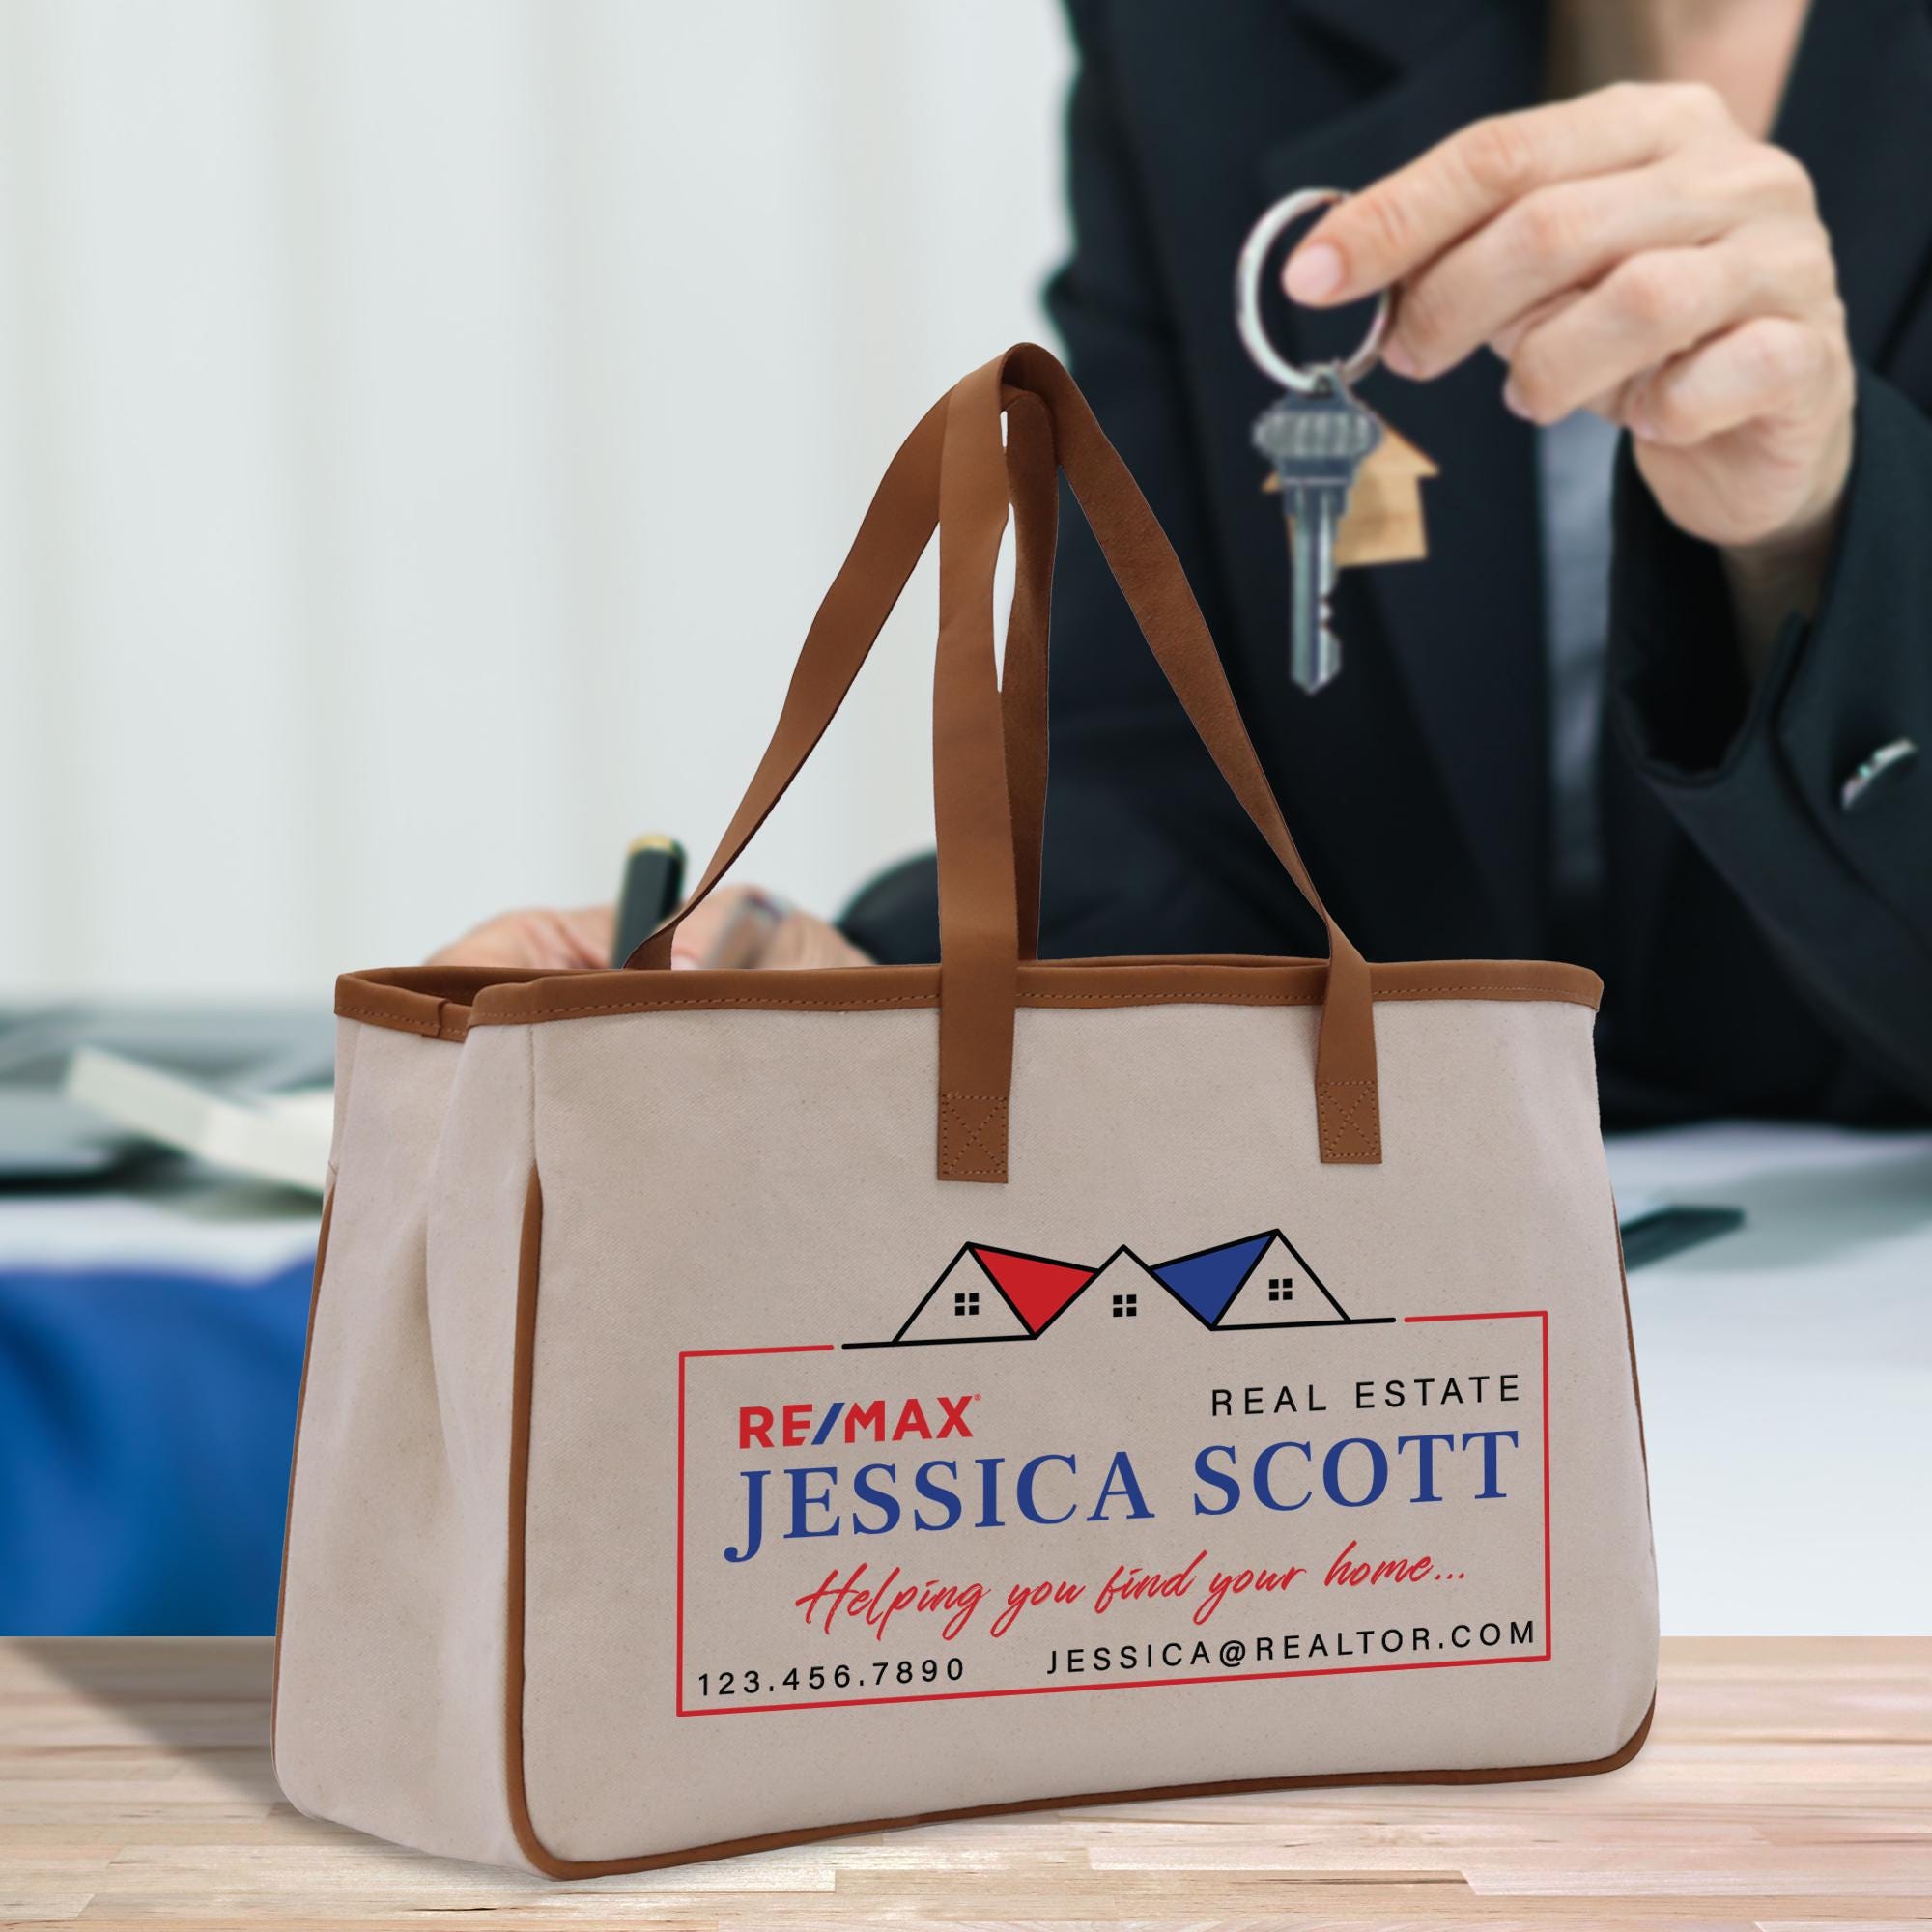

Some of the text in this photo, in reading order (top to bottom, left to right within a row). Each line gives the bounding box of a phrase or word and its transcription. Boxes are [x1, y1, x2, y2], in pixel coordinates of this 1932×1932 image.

[1211, 1374, 1520, 1417] REAL ESTATE
[724, 1430, 1519, 1563] JESSICA SCOTT
[794, 1540, 1466, 1642] Helping you find your home...
[1046, 1620, 1533, 1675] JESSICA@REALTOR.COM
[698, 1657, 963, 1696] 123.456.7890
